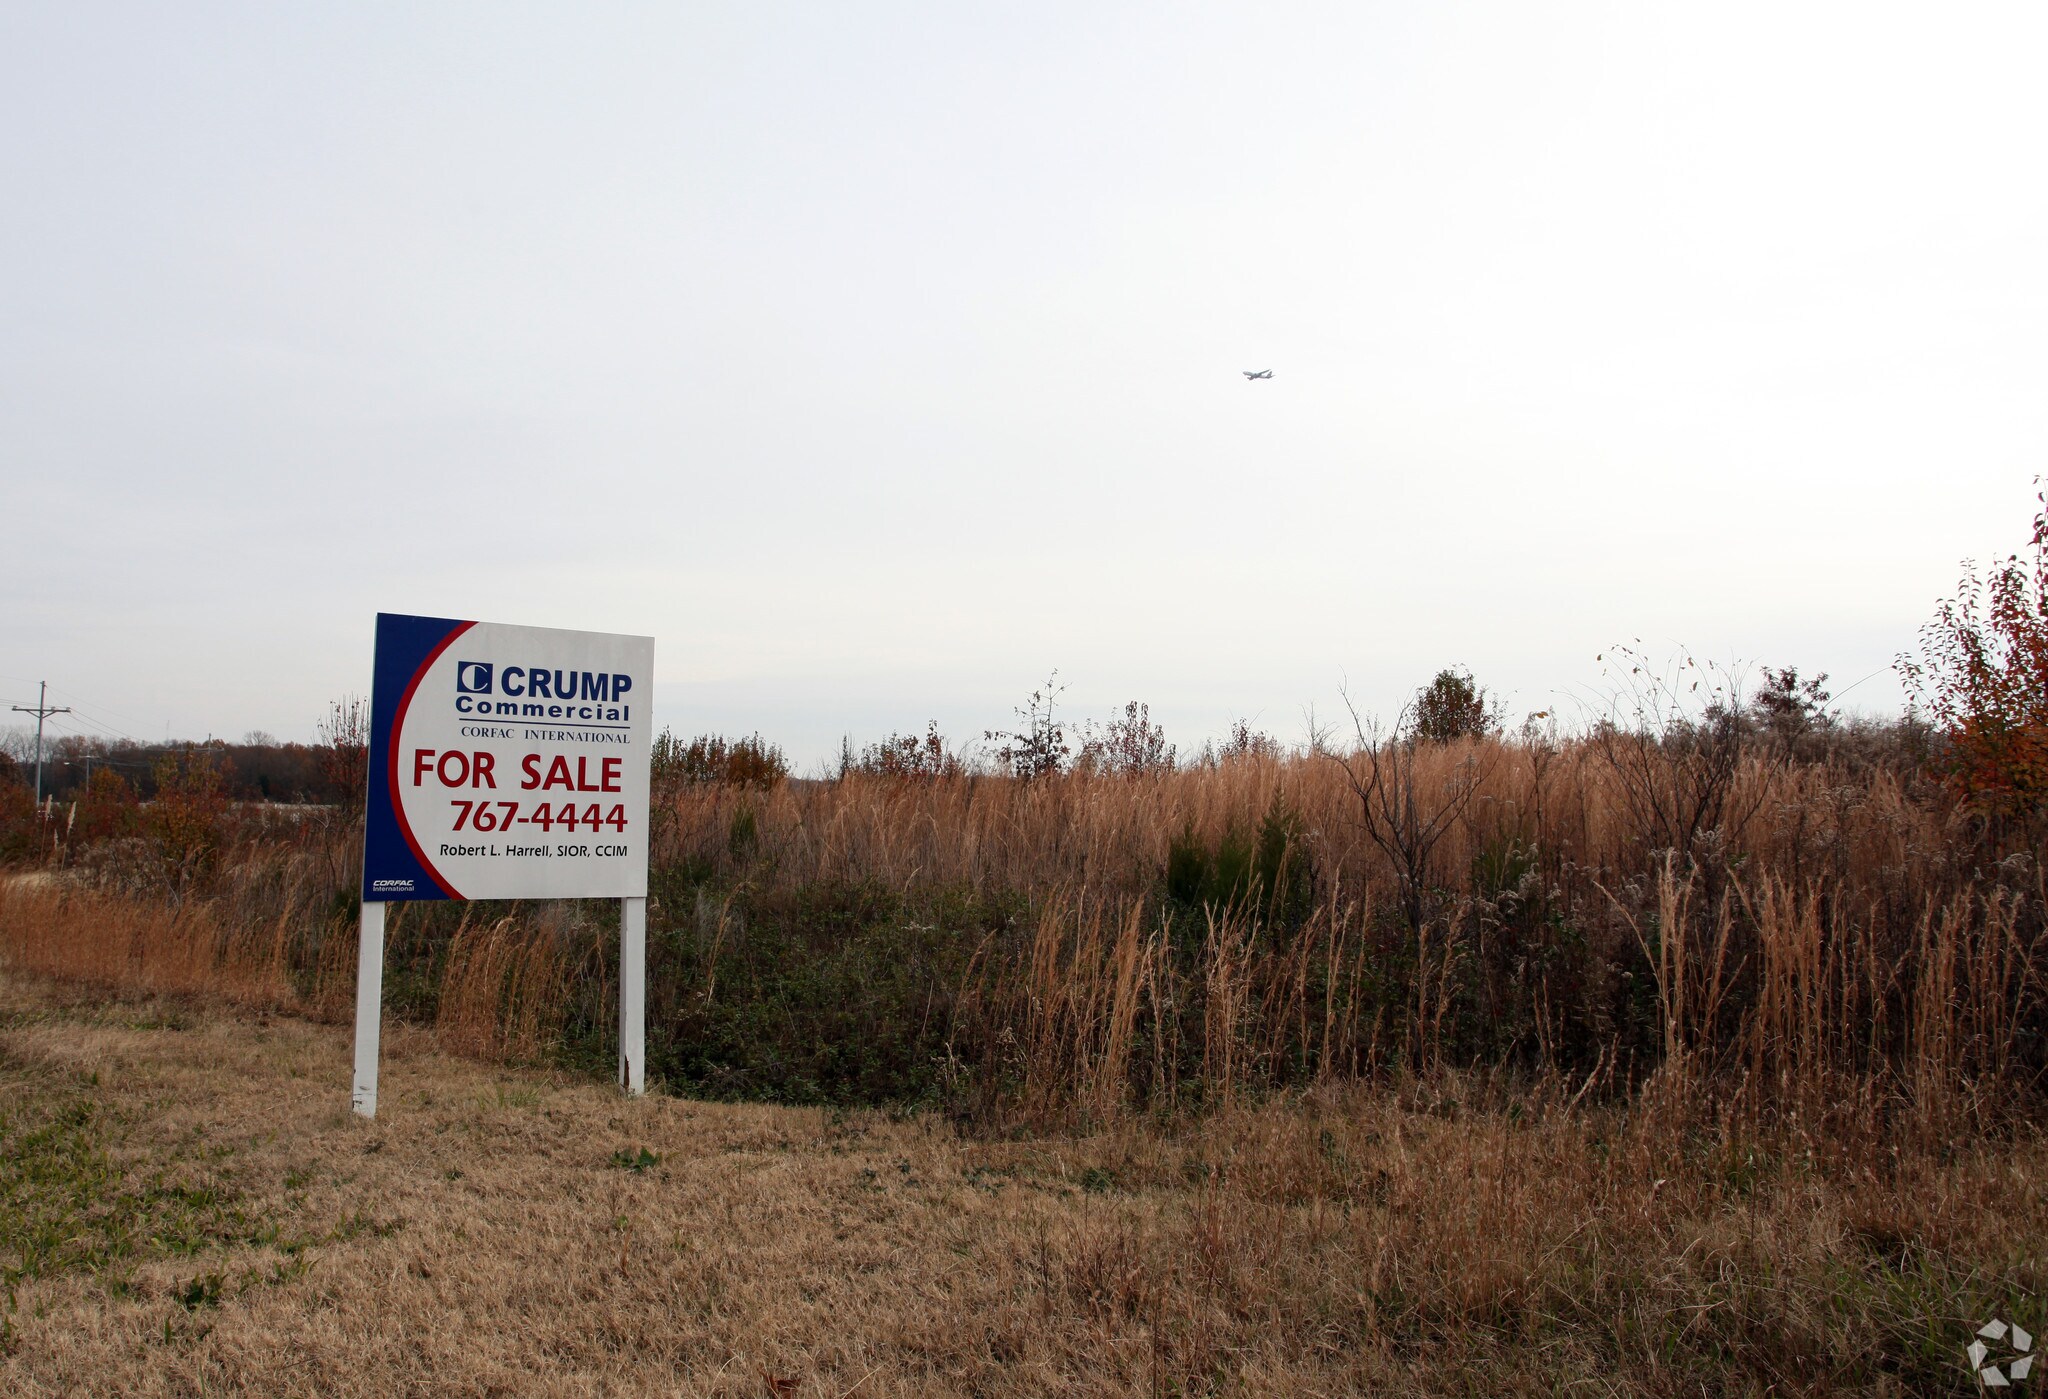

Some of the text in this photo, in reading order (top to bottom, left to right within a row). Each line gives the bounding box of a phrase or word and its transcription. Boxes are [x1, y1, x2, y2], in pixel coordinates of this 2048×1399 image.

[501, 666, 632, 702] CRUMP
[455, 696, 629, 721] Commercial
[461, 726, 630, 744] CORFAC INTERNATIONAL
[413, 748, 622, 793] FOR SALE
[450, 800, 628, 833] 767-4444
[440, 844, 628, 858] Robert L. Harrell, SIOR, CCIM
